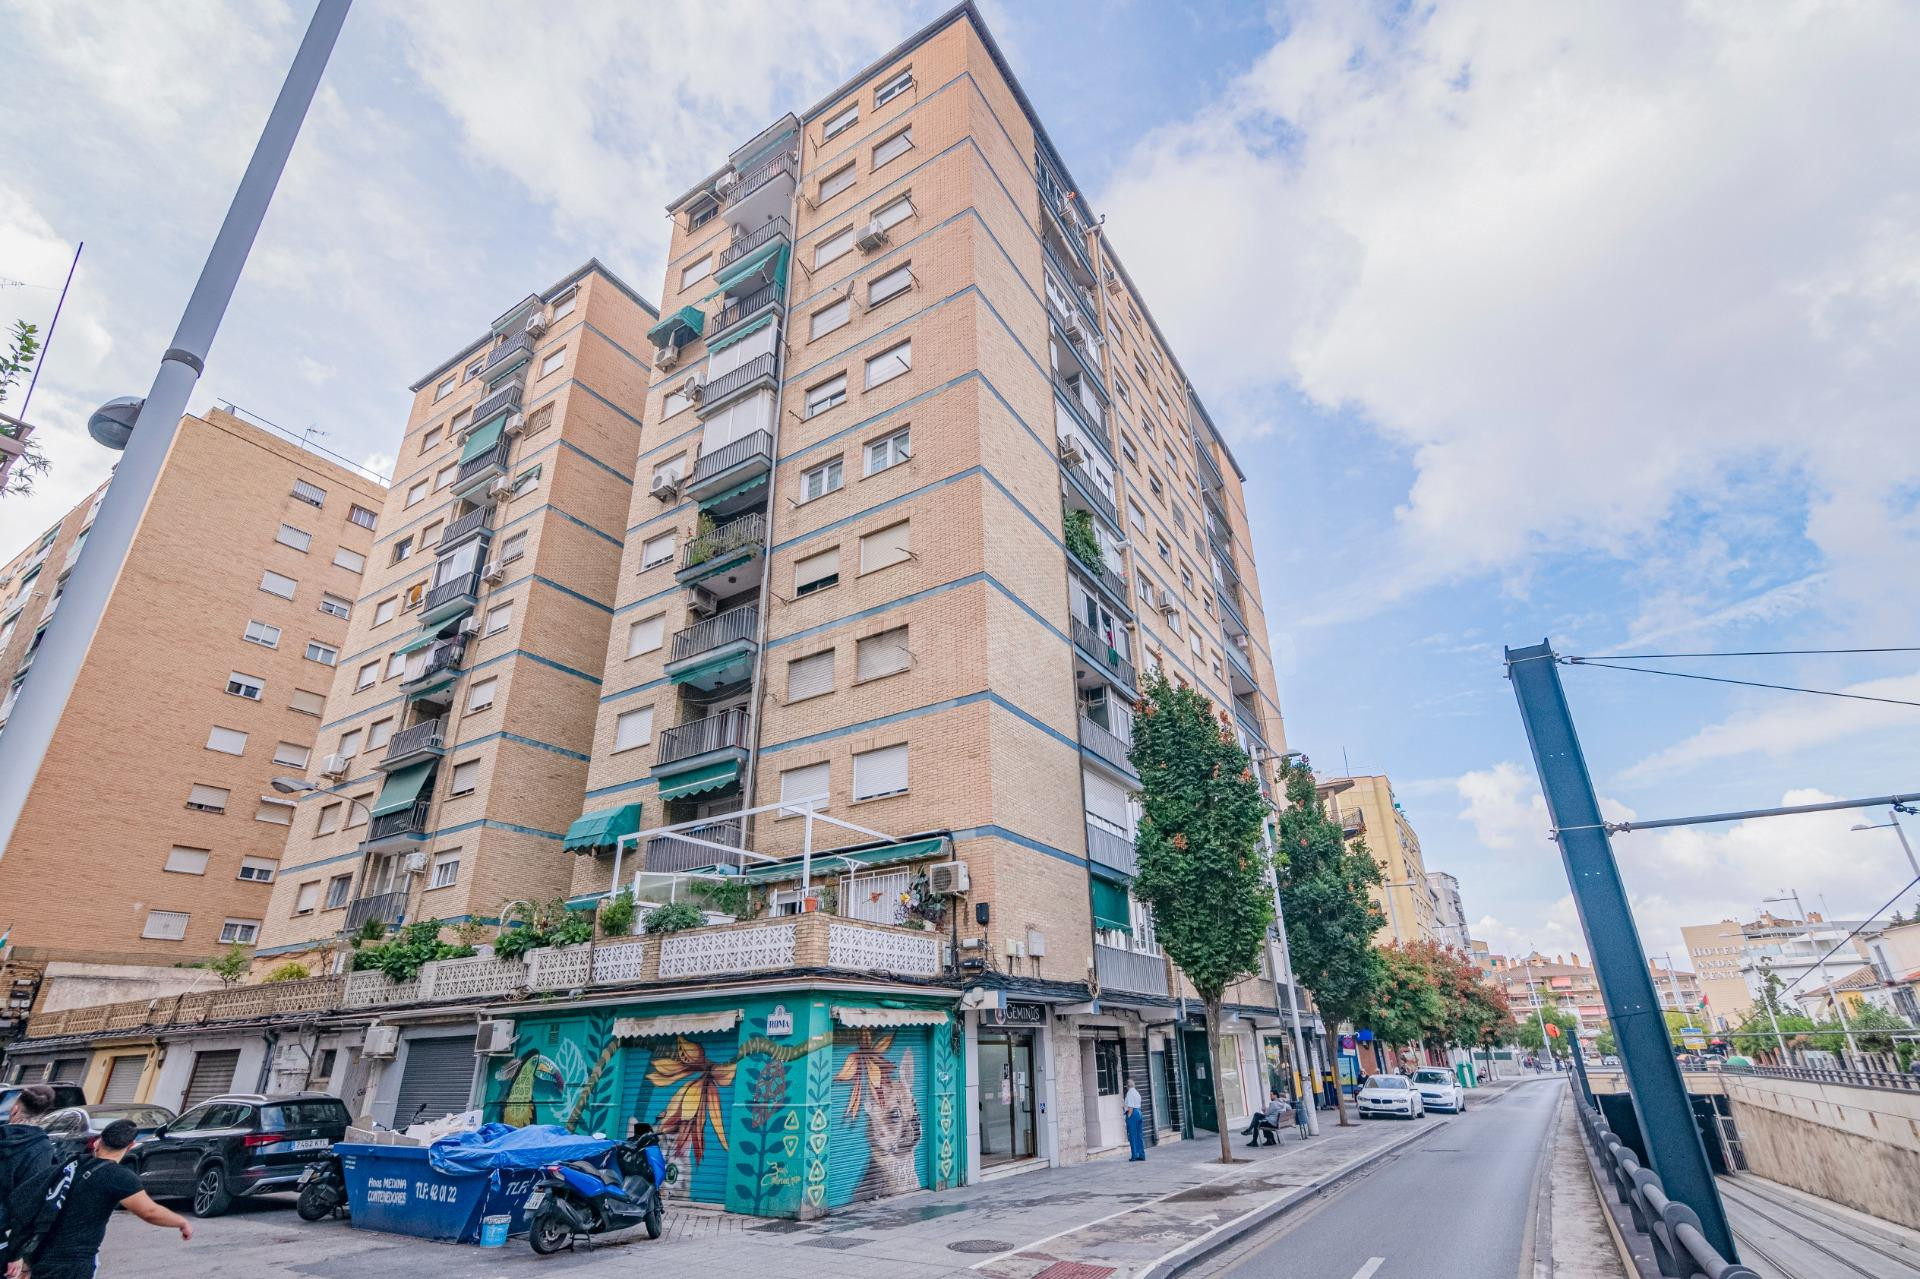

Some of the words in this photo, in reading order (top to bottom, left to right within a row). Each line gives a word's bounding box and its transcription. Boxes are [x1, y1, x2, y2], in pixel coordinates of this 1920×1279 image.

[1692, 945, 1739, 957] HOTEL
[769, 1020, 790, 1029] ROMA
[383, 1177, 407, 1190] MEDINA
[368, 1190, 407, 1204] CONTENEDORES
[448, 1186, 457, 1203] 22
